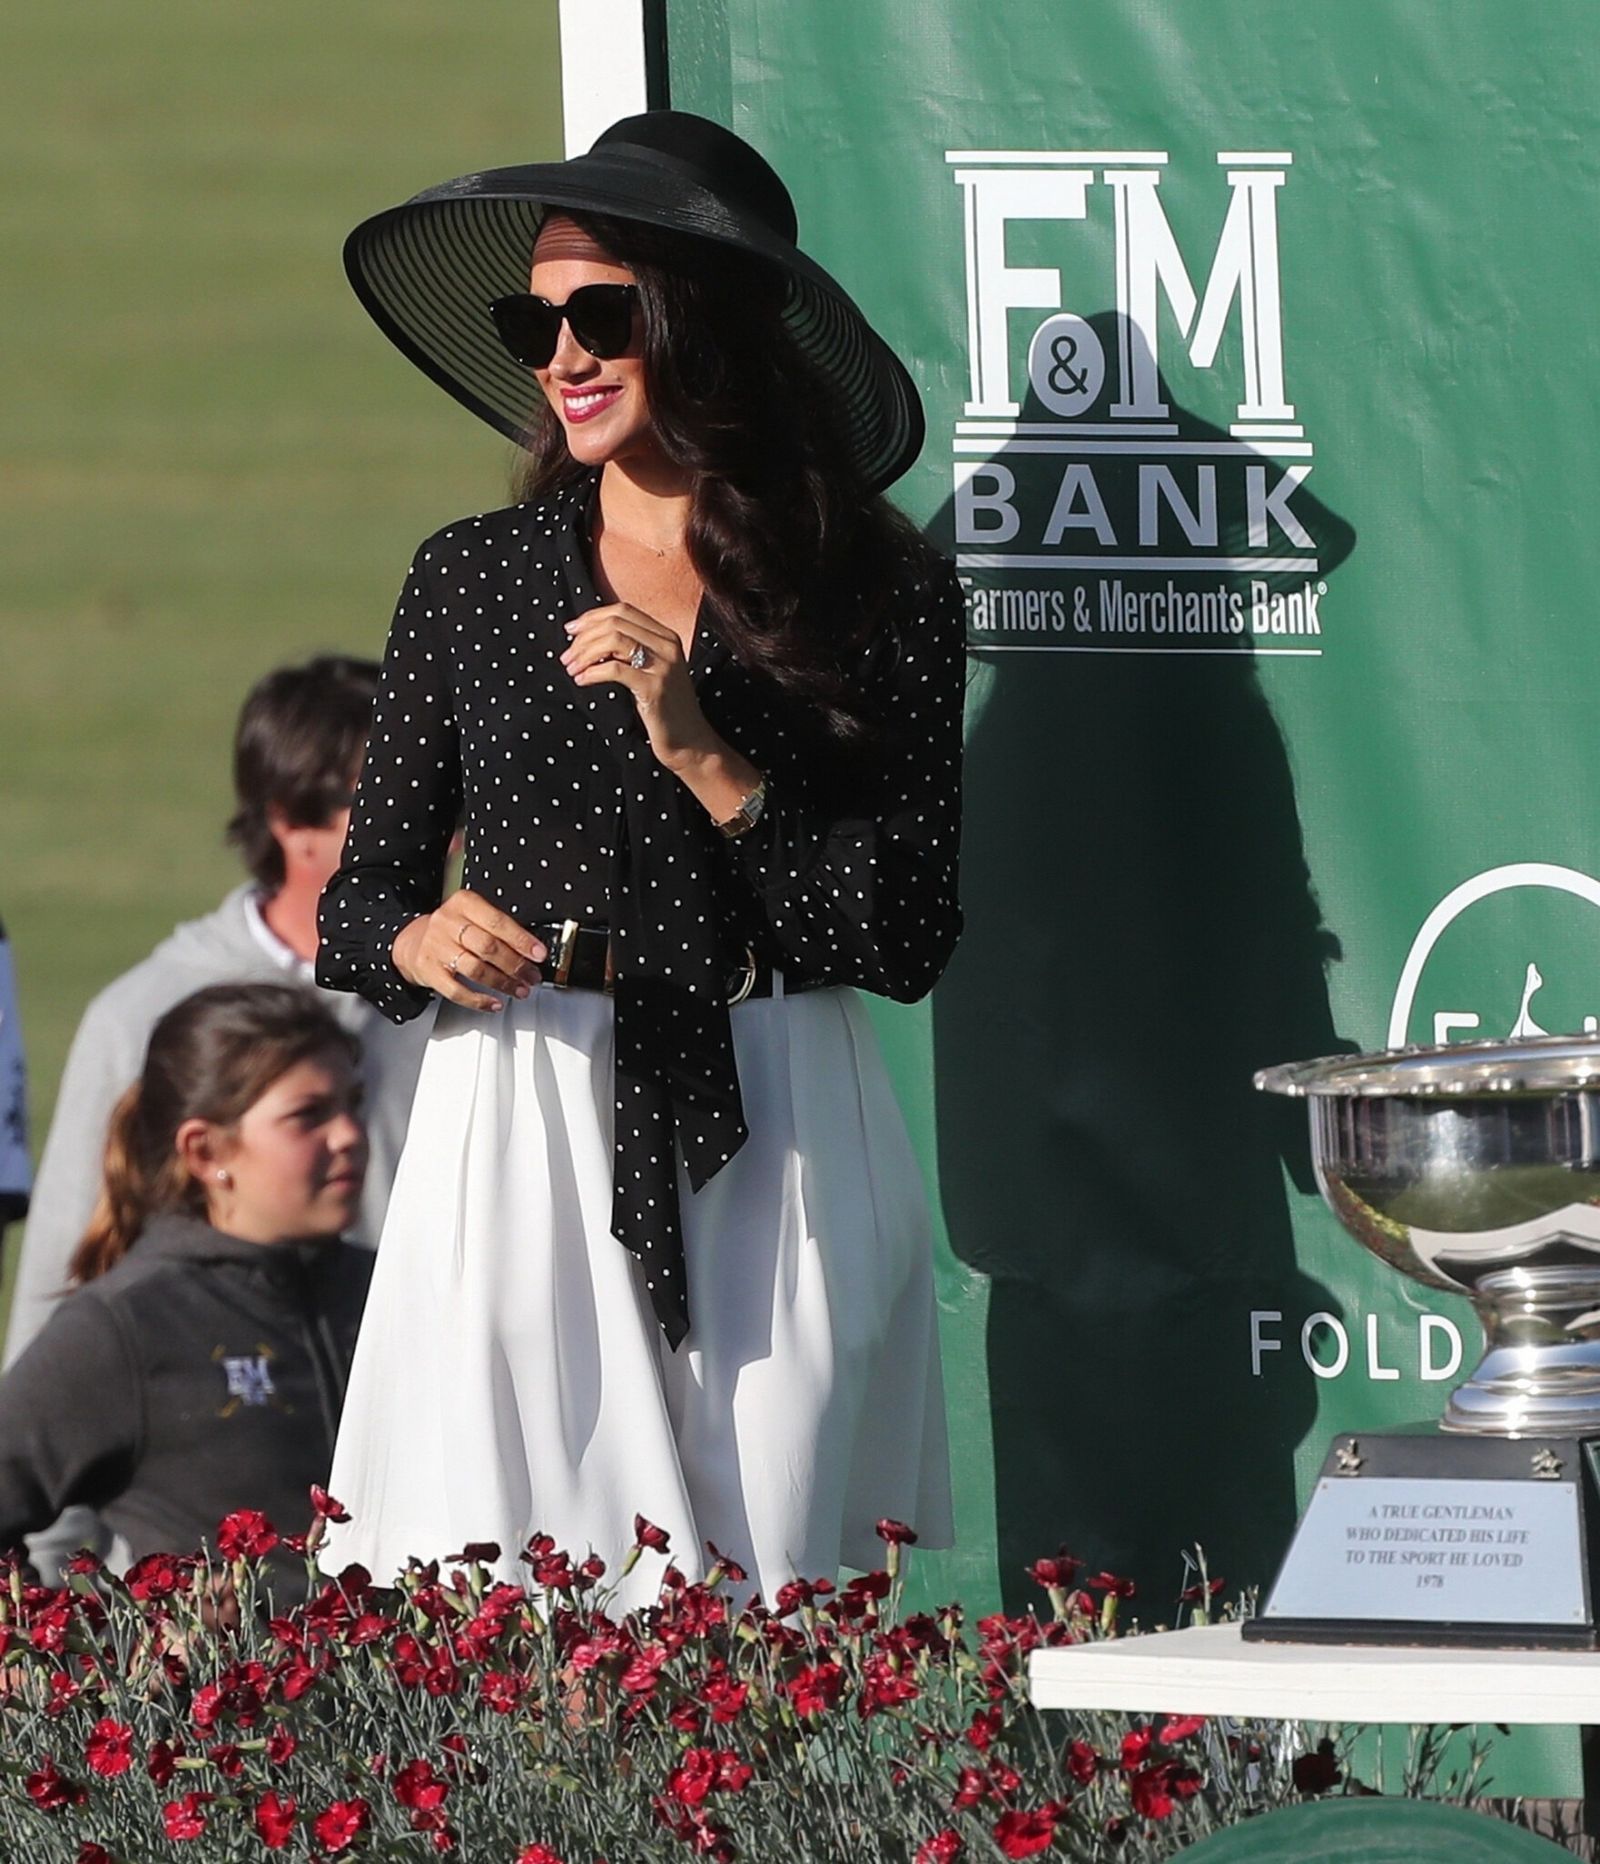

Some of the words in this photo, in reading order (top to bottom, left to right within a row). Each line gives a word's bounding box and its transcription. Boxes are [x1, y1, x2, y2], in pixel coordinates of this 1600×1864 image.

[952, 460, 1318, 549] BANK
[1073, 585, 1093, 633] &
[1099, 578, 1245, 636] Merchants
[1368, 1505, 1379, 1520] A
[1381, 1504, 1421, 1520] TRUE
[1422, 1505, 1514, 1521] GENTLEMAN
[1346, 1527, 1382, 1542] WHO
[1383, 1527, 1468, 1543] DEDICATED
[1469, 1529, 1494, 1543] HIS
[1497, 1530, 1530, 1545] LIFE
[1346, 1550, 1366, 1565] TO
[1368, 1550, 1398, 1565] THE
[1399, 1551, 1446, 1566] SPORT
[1449, 1552, 1471, 1567] HE
[1473, 1553, 1523, 1568] LOVED
